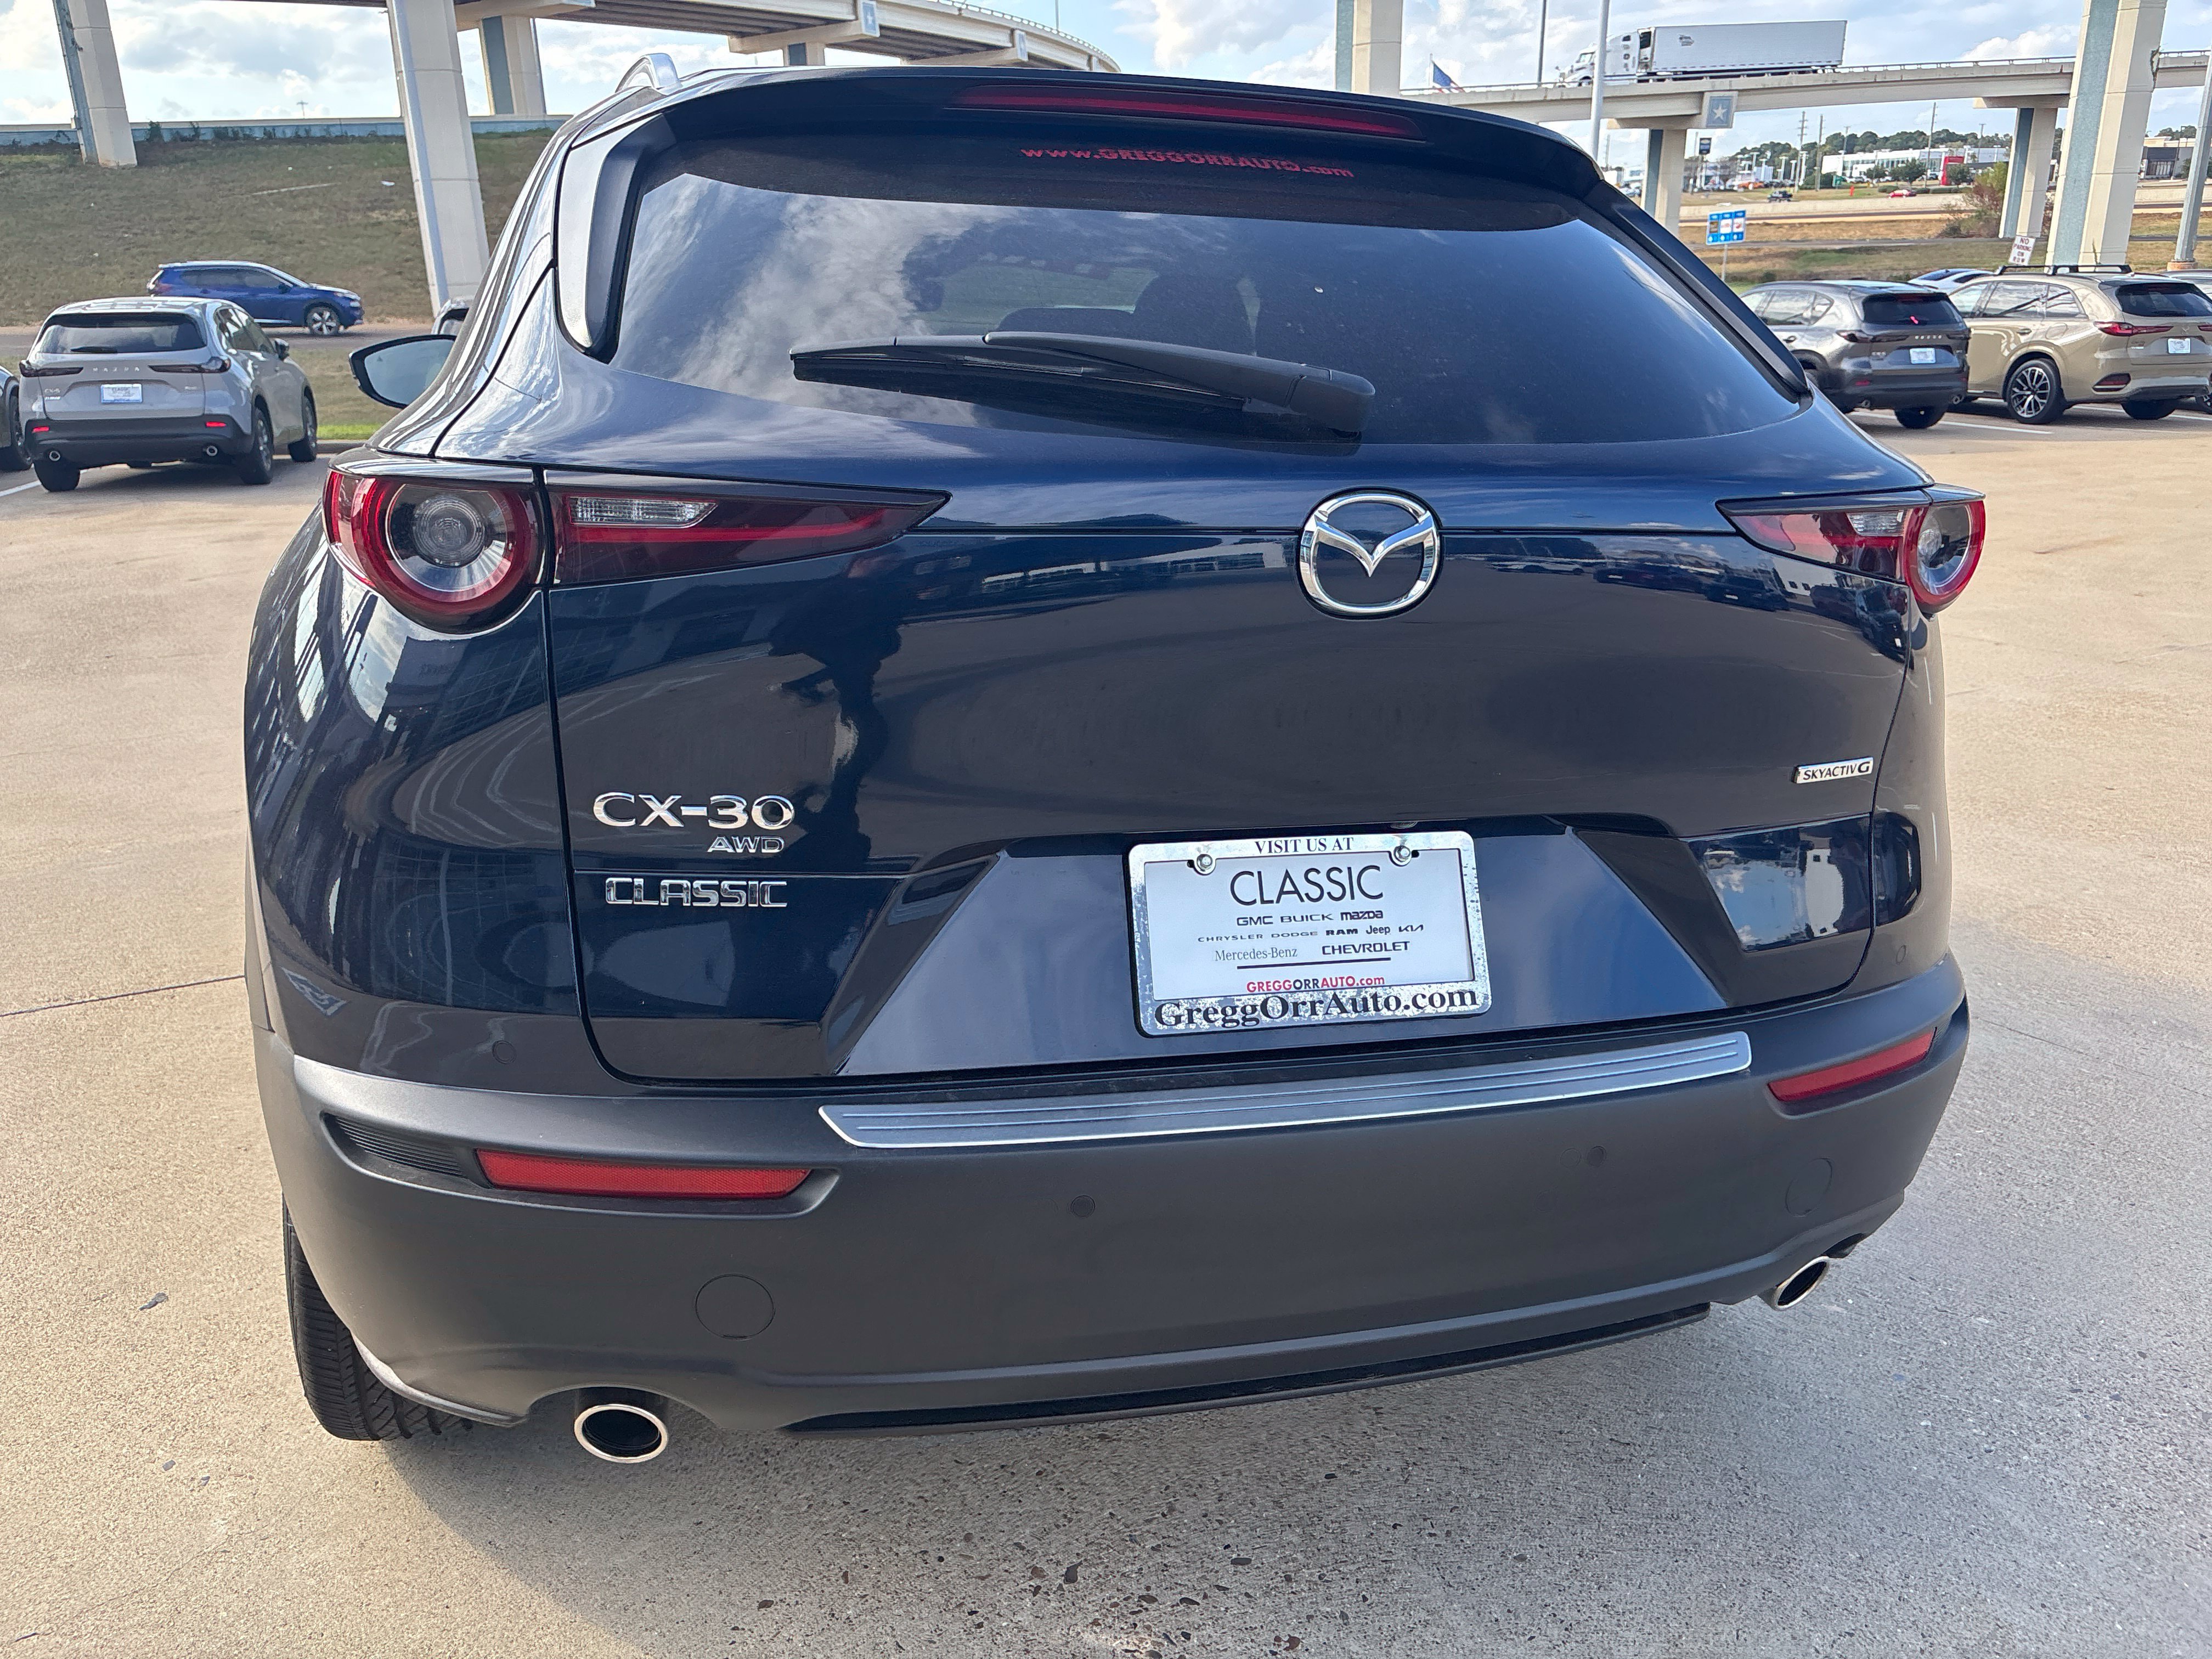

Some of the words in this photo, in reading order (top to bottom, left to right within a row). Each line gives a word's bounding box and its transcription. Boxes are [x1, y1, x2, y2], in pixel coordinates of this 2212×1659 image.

[593, 791, 795, 830] CX-30
[707, 836, 785, 853] AWD
[1254, 840, 1303, 854] VISIT
[1306, 839, 1327, 852] US
[1330, 837, 1354, 851] AT
[605, 878, 788, 907] CLASSIC
[1230, 865, 1384, 905] CLASSIC
[1237, 916, 1273, 926] GMC
[1280, 912, 1334, 923] BUICK
[1198, 934, 1263, 943] CHRYSLER
[1365, 925, 1391, 936] Jeep
[1215, 947, 1298, 962] Mercedes-Benz
[1322, 941, 1410, 956] CHEVROLET
[1246, 975, 1385, 993] GREGGORRAUTO.com
[1154, 989, 1477, 1028] GreggOrrAuto.com
